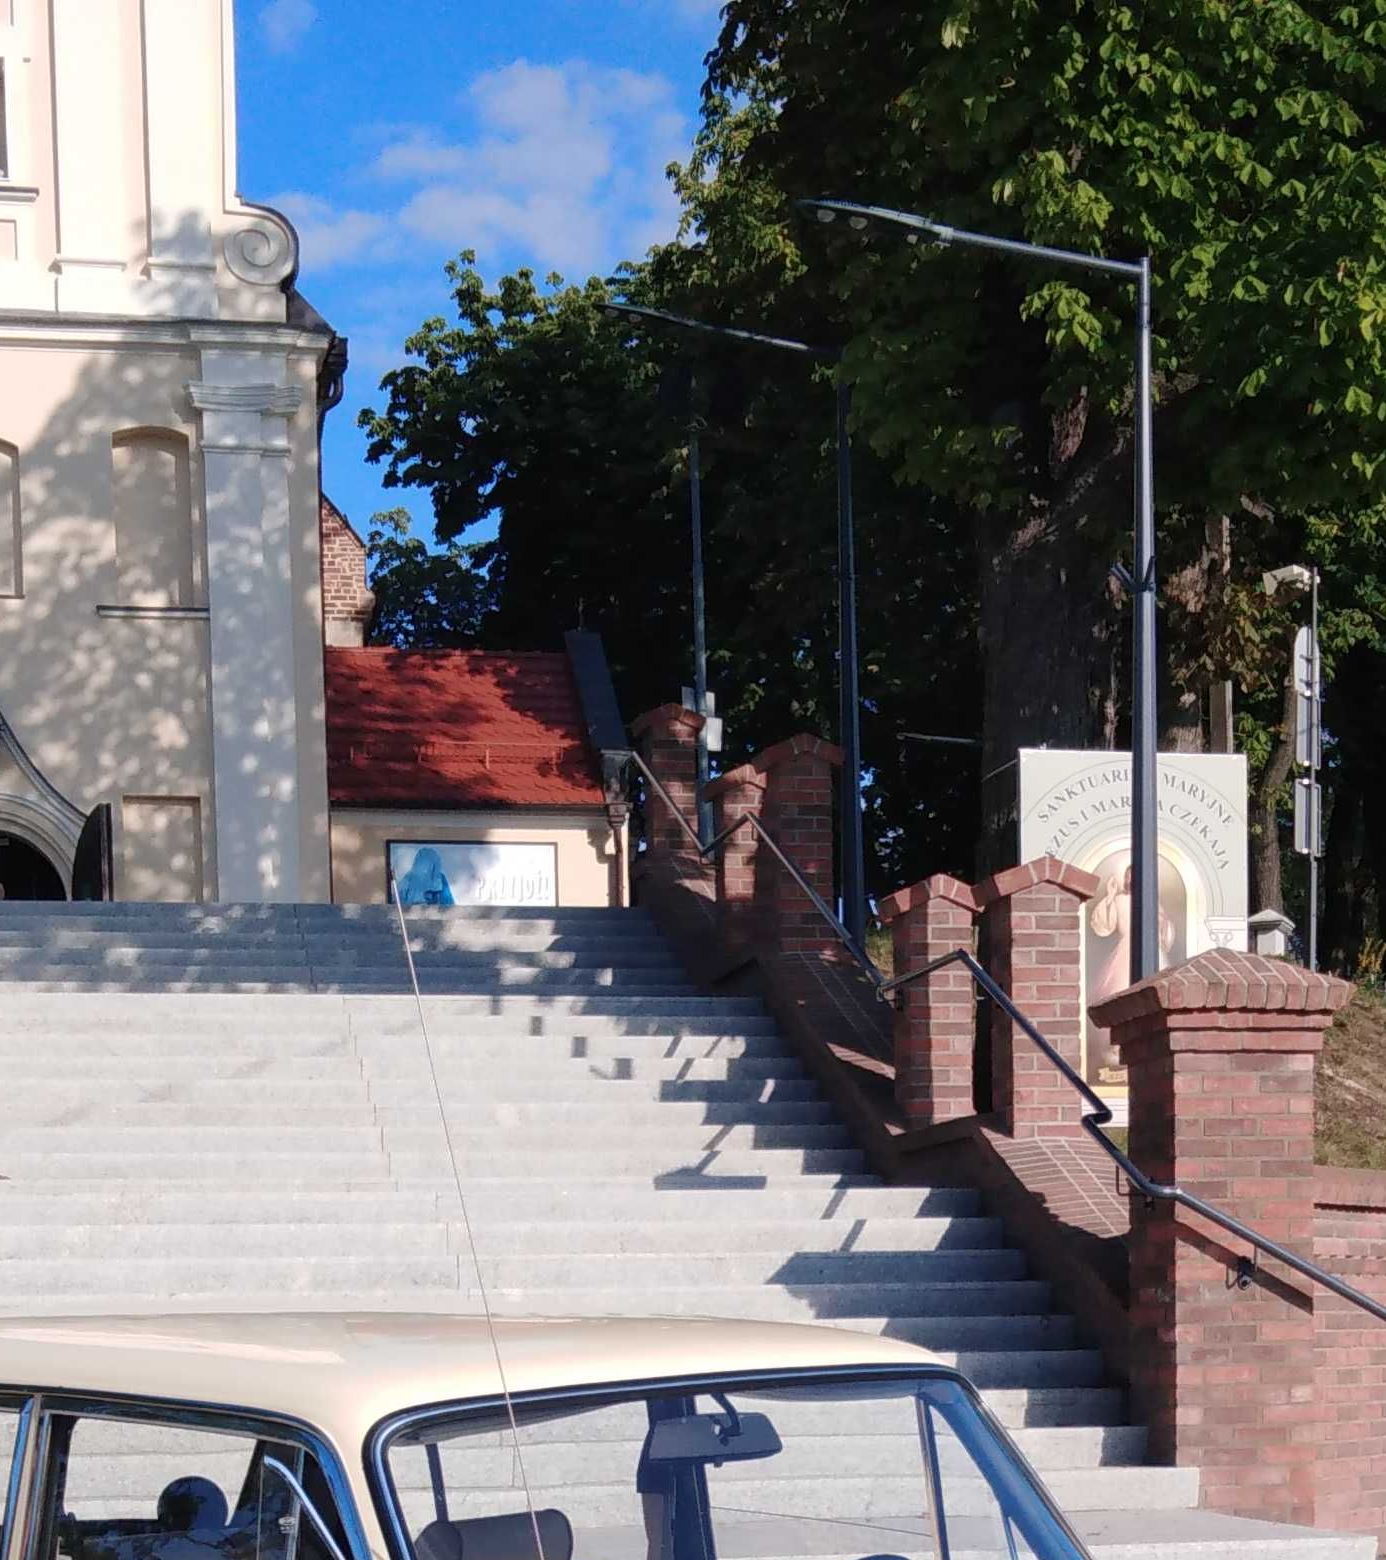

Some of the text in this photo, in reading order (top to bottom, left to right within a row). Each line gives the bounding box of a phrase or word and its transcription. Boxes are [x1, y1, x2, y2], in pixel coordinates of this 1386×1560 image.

[1037, 768, 1235, 828] SANKTUARI MARYJNE
[1045, 816, 1080, 858] EZUS
[1080, 809, 1089, 821] I
